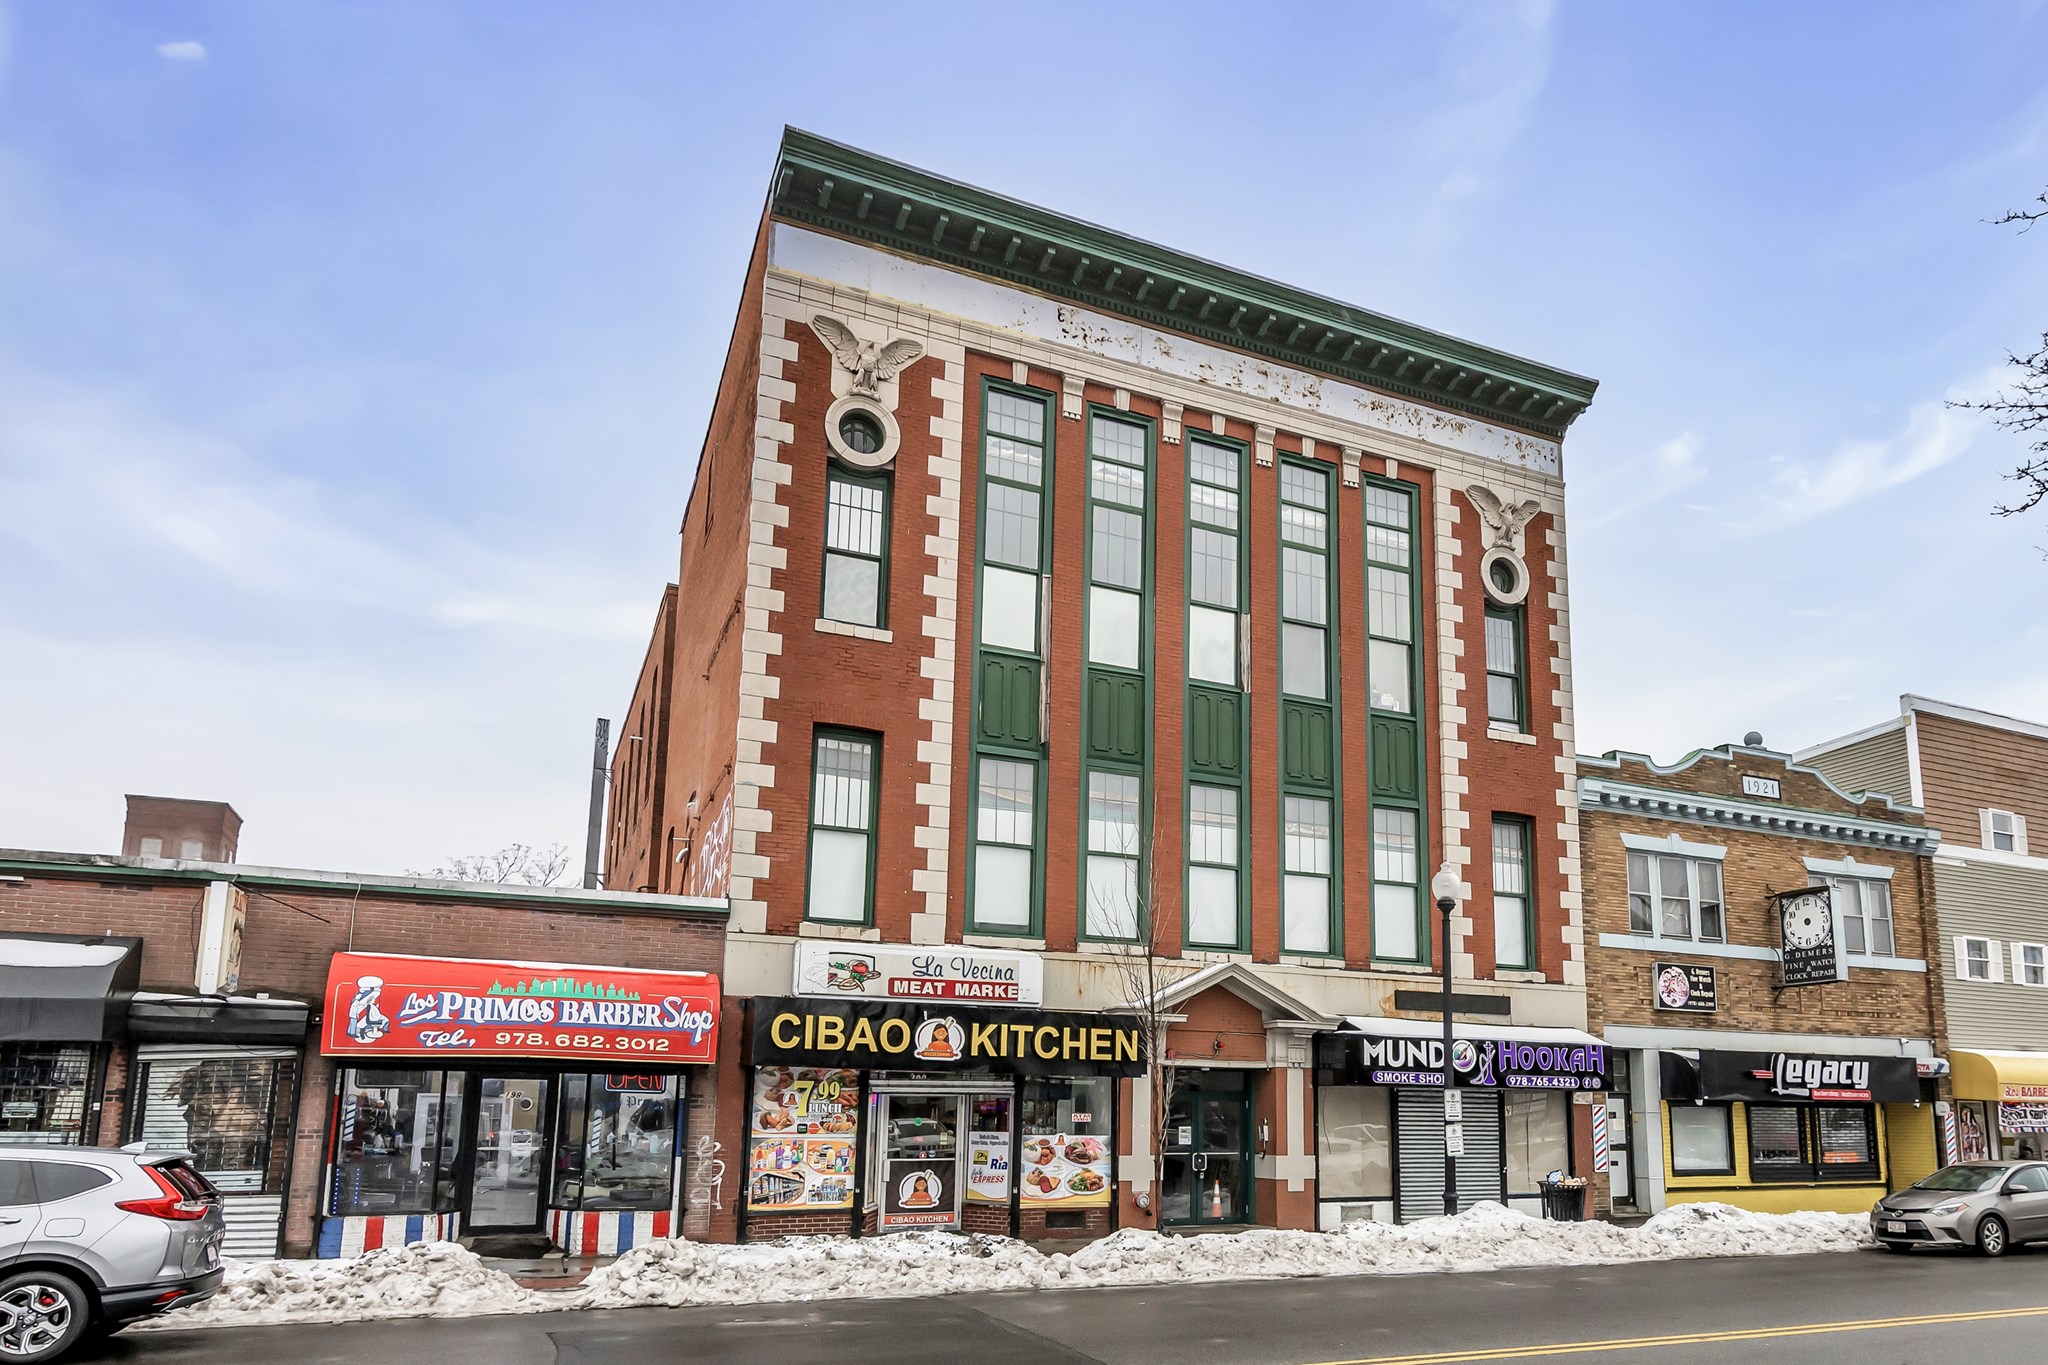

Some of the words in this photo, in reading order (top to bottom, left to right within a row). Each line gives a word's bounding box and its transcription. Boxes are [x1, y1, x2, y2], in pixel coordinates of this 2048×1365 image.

[1747, 780, 1775, 795] 1921
[1795, 902, 1800, 911] 11
[1802, 897, 1810, 907] 12
[1814, 899, 1818, 908] 1
[1819, 905, 1826, 914] 2
[1788, 911, 1796, 920] 10
[1822, 914, 1829, 924] 3
[1786, 920, 1792, 929] 9
[1789, 930, 1796, 939] 8
[1805, 937, 1811, 946] 6
[1795, 947, 1834, 959] DEMERS
[912, 954, 944, 978] La
[950, 956, 1015, 981] Vecina
[1785, 961, 1804, 970] FINE
[1786, 971, 1808, 980] CLOCK
[1811, 968, 1836, 977] REPAIR
[893, 980, 946, 996] MEAT
[954, 982, 1019, 999] MARKE
[400, 992, 438, 1018] Los
[436, 991, 556, 1024] PRIMOS
[559, 1000, 664, 1028] BARBER
[663, 996, 715, 1043] Shop
[770, 1012, 911, 1054] CIBAO
[970, 1022, 1139, 1062] KITCHEN
[1498, 1041, 1605, 1076] HOOKAH
[1376, 1072, 1416, 1083] SMOKE
[1770, 1053, 1869, 1097] Legacy
[1509, 1076, 1576, 1087] 978.765.4321
[505, 1091, 522, 1099] 198
[793, 1080, 840, 1118] 7.99
[808, 1103, 842, 1114] LUNCH
[990, 1155, 1008, 1170] Ria
[972, 1175, 1005, 1184] EXPRESS
[890, 1216, 915, 1224] CIBAO
[916, 1215, 949, 1223] KITCHEN
